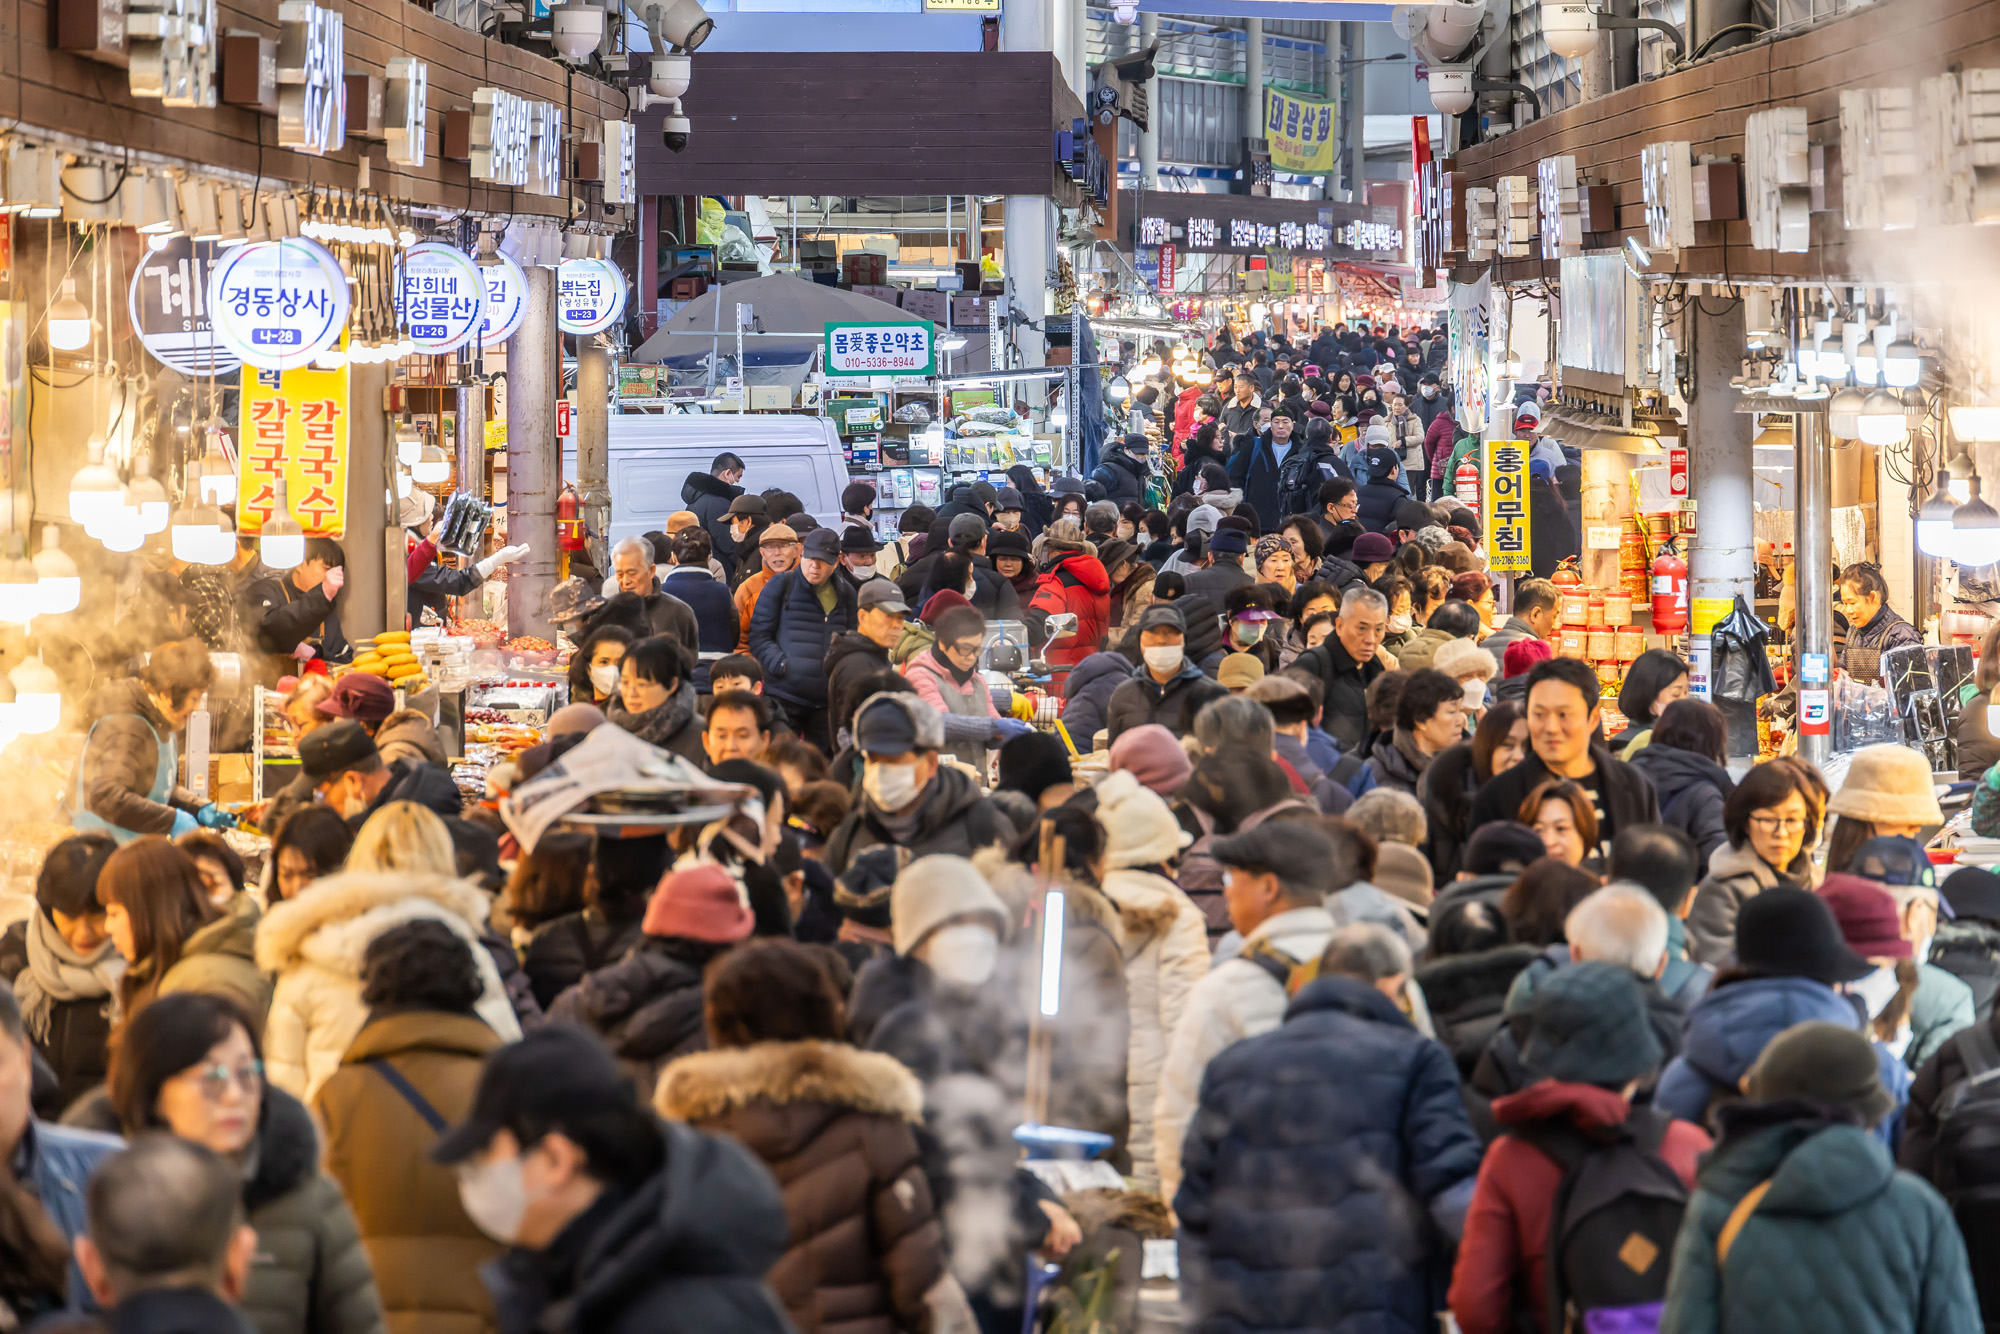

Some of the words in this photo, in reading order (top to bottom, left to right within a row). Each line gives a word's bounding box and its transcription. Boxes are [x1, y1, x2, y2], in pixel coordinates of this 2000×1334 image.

[1187, 216, 1215, 248] 충남인삼
[144, 258, 217, 317] 계
[405, 277, 457, 295] 진희네
[227, 287, 329, 318] 경동상사
[571, 310, 592, 319] 나-23
[259, 330, 294, 343] 나-28
[415, 327, 444, 337] 나-26
[845, 356, 915, 368] 010-5336-8944
[298, 400, 341, 528] 칼국수
[1493, 447, 1525, 551] 홍어무침
[1491, 555, 1530, 565] 010-2760-3360
